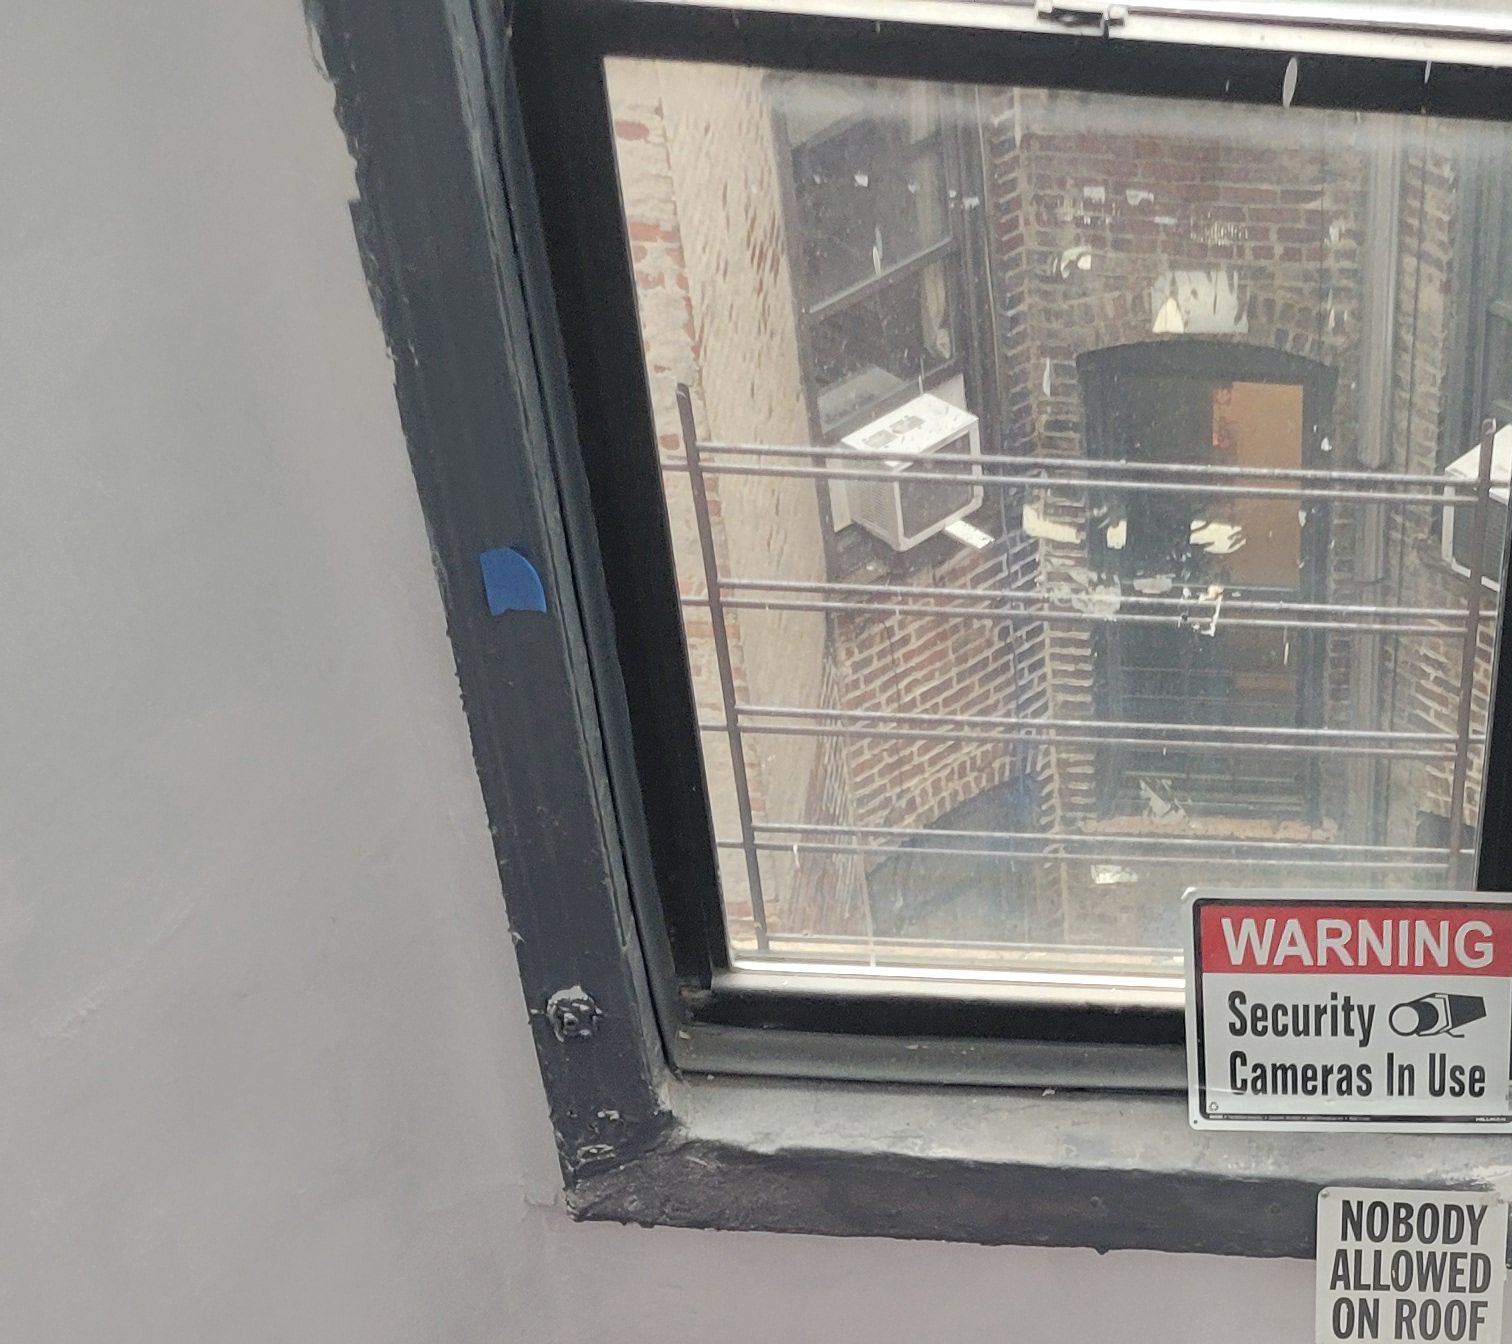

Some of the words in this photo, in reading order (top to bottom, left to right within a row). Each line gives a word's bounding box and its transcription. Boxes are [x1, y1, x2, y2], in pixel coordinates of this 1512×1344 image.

[1221, 918, 1494, 968] WARNING
[1228, 990, 1376, 1047] Security
[1229, 1050, 1373, 1096] Cameras
[1387, 1052, 1415, 1096] In
[1428, 1053, 1486, 1097] Use
[1341, 1199, 1488, 1245] NOBODY
[1329, 1248, 1492, 1293] ALLOWED
[1332, 1297, 1380, 1339] ON
[1394, 1298, 1488, 1341] ROOF
